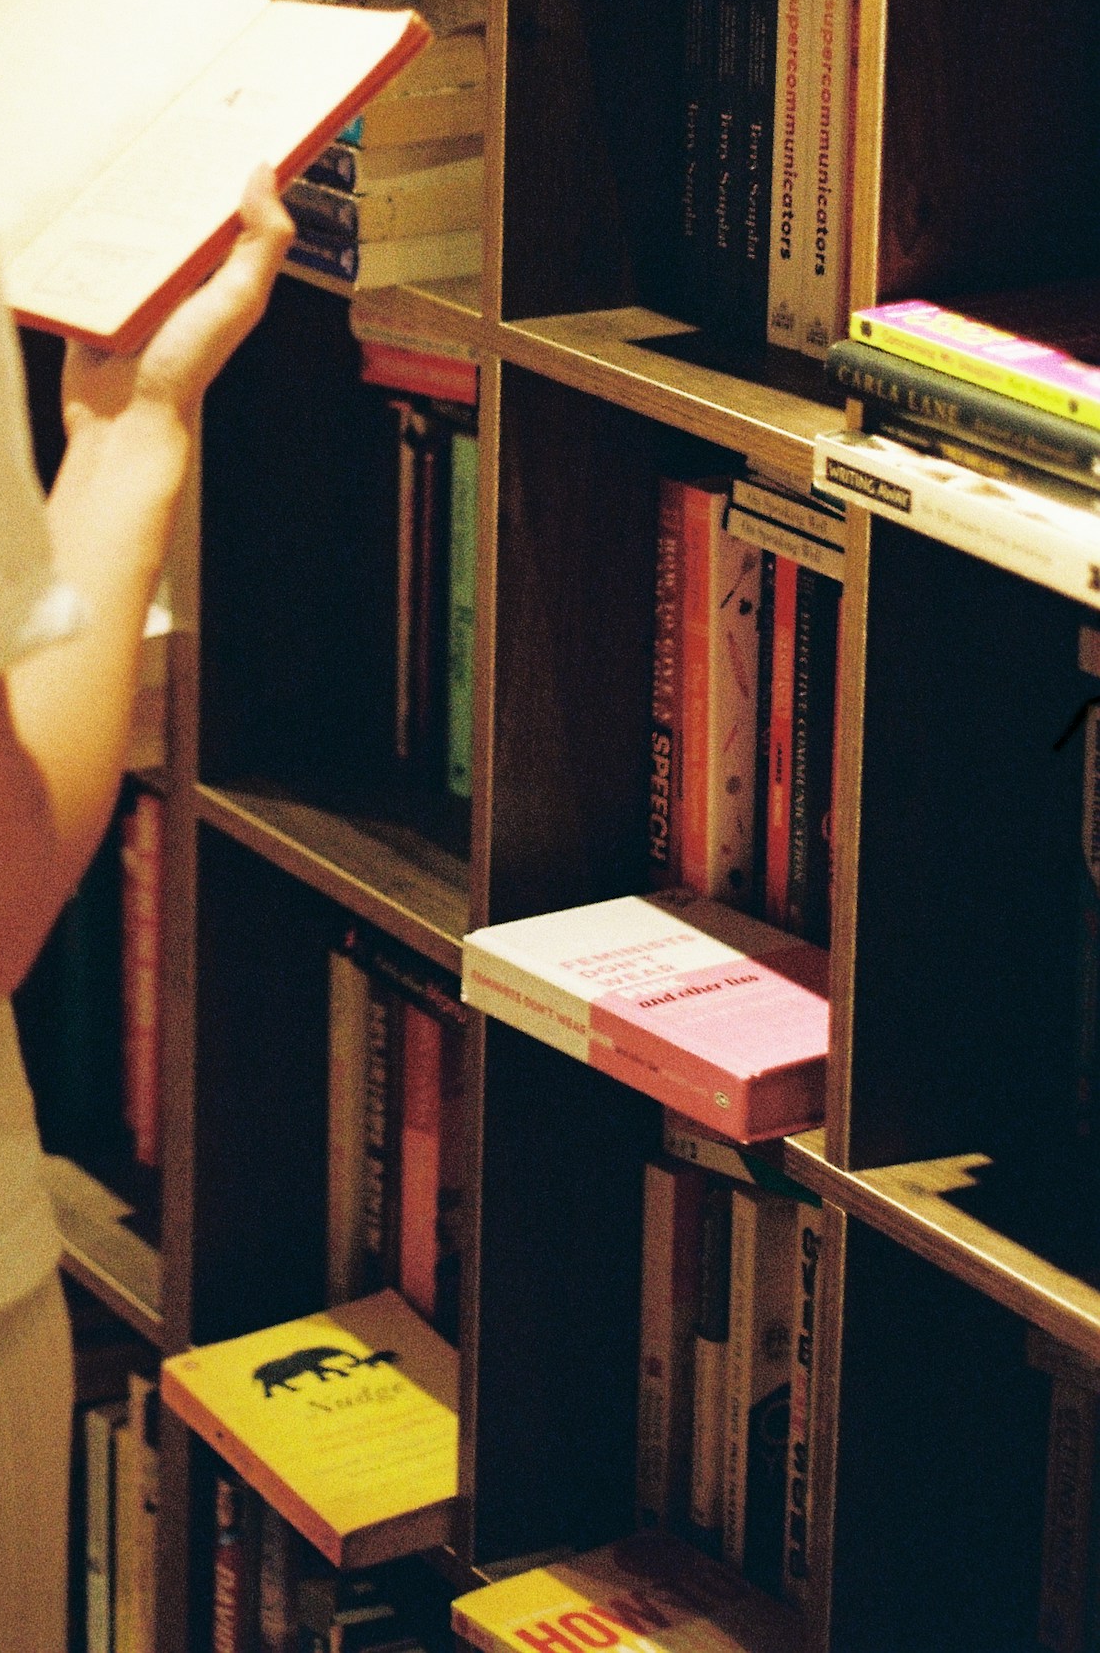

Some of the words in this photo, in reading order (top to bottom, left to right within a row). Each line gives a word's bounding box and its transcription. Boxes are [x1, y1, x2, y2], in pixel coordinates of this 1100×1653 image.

[650, 730, 671, 861] SPEECH
[559, 931, 698, 971] FEMINISTS
[579, 952, 657, 980] DON'T
[638, 993, 680, 1009] and
[680, 982, 725, 1005] other
[727, 972, 760, 990] lies
[308, 1381, 407, 1413] Nudge
